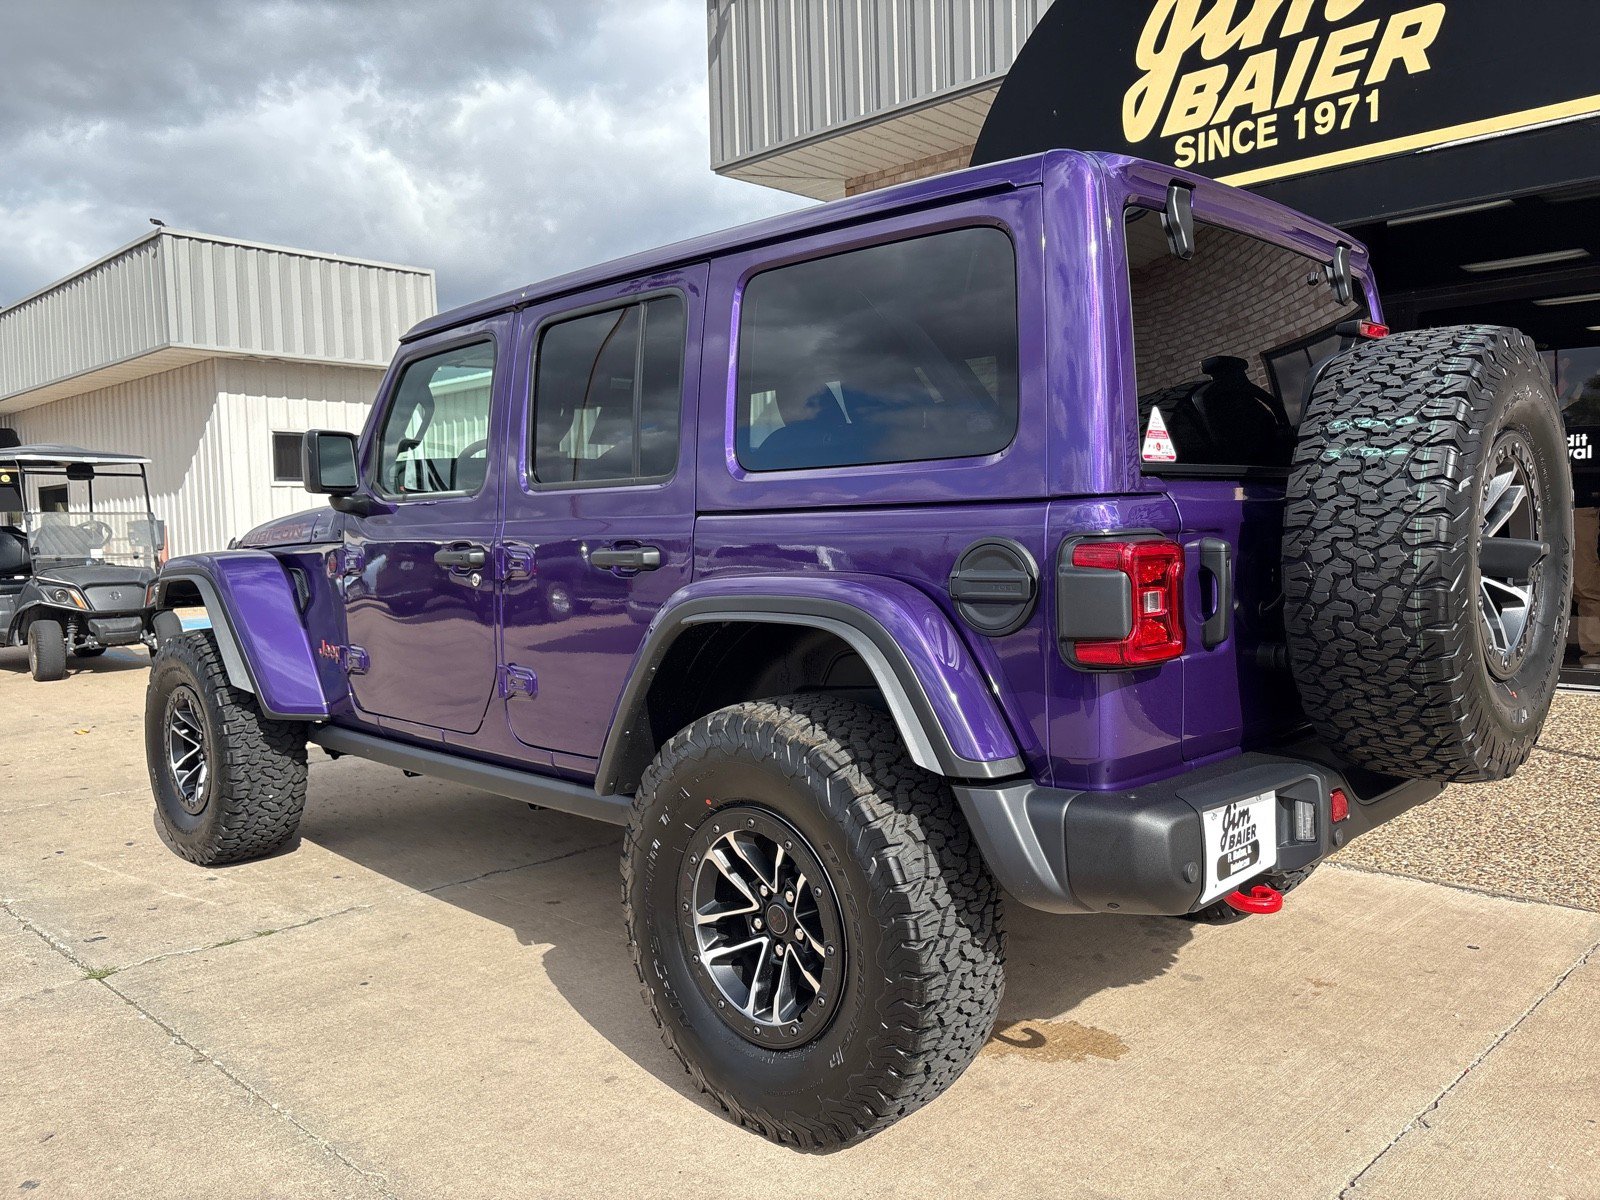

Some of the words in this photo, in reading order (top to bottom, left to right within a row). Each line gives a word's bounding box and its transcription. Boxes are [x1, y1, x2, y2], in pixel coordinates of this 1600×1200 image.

[1160, 3, 1446, 138] BAIER
[1174, 113, 1278, 168] SINCE
[1294, 89, 1380, 140] 1971
[1220, 802, 1252, 853] Jim
[1228, 823, 1256, 850] BAIER
